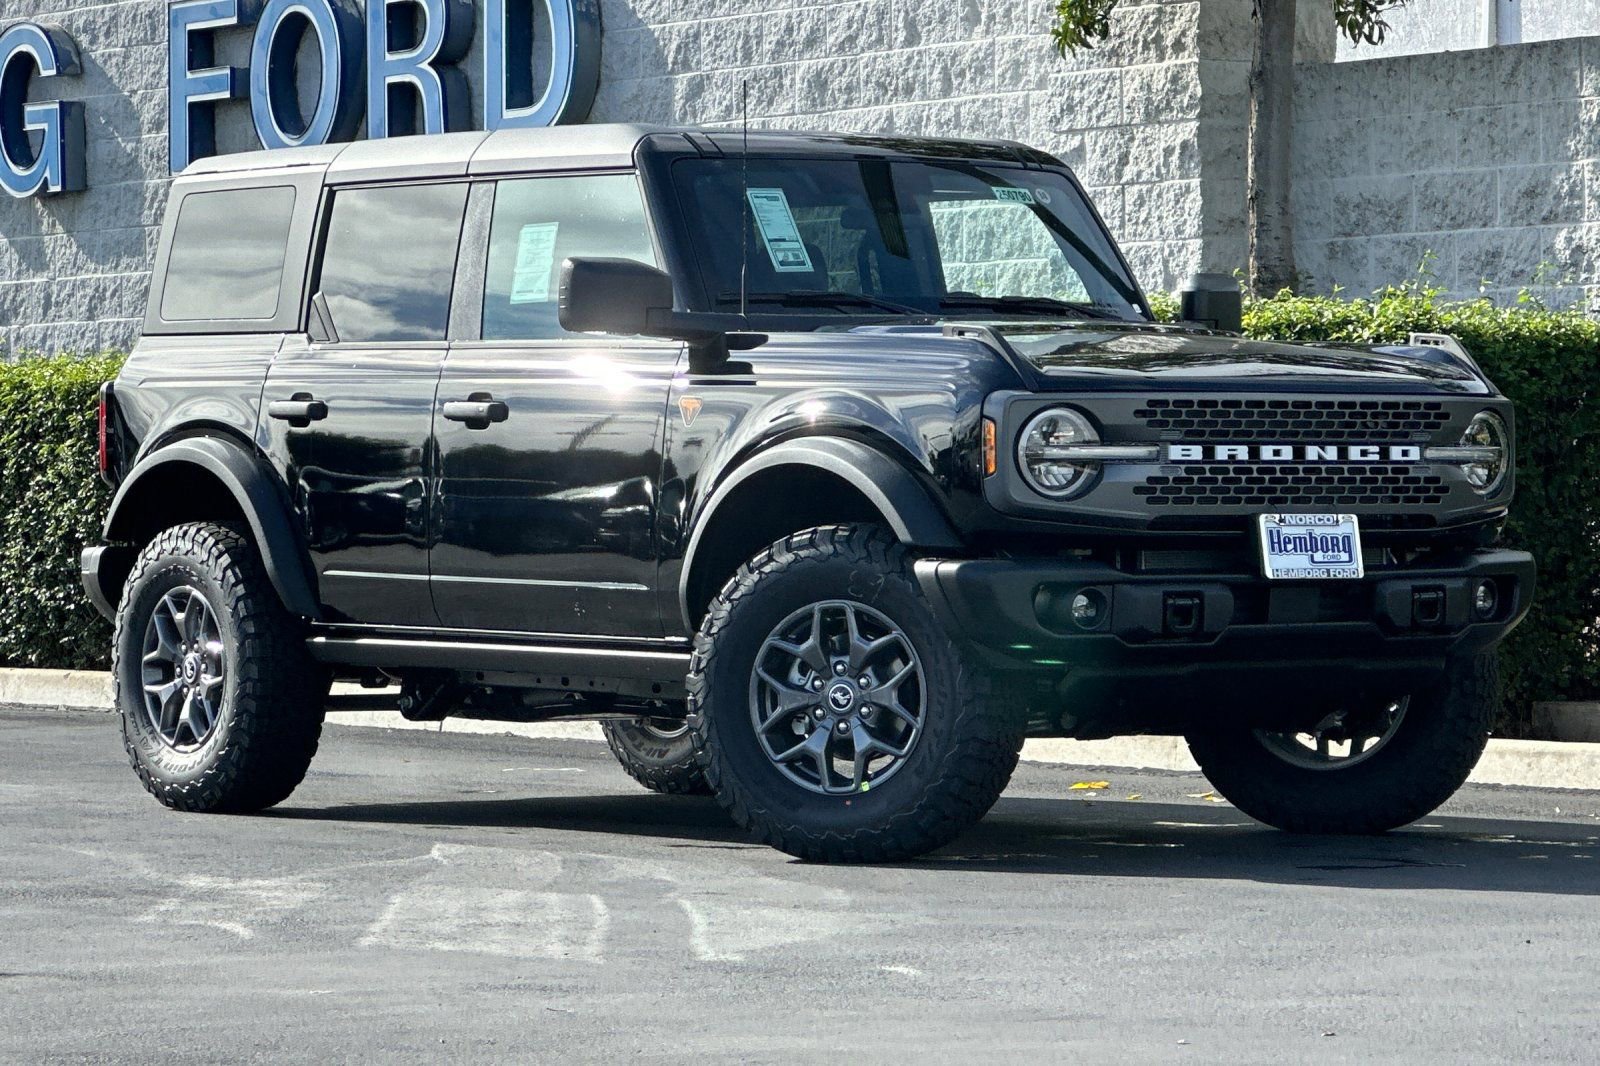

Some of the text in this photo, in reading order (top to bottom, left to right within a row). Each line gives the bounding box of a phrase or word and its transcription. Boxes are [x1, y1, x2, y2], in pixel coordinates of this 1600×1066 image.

[168, 0, 577, 175] FORD
[1168, 445, 1420, 461] BRONCO
[1286, 515, 1334, 525] NORCO
[1273, 569, 1358, 578] HEMBORG FORD
